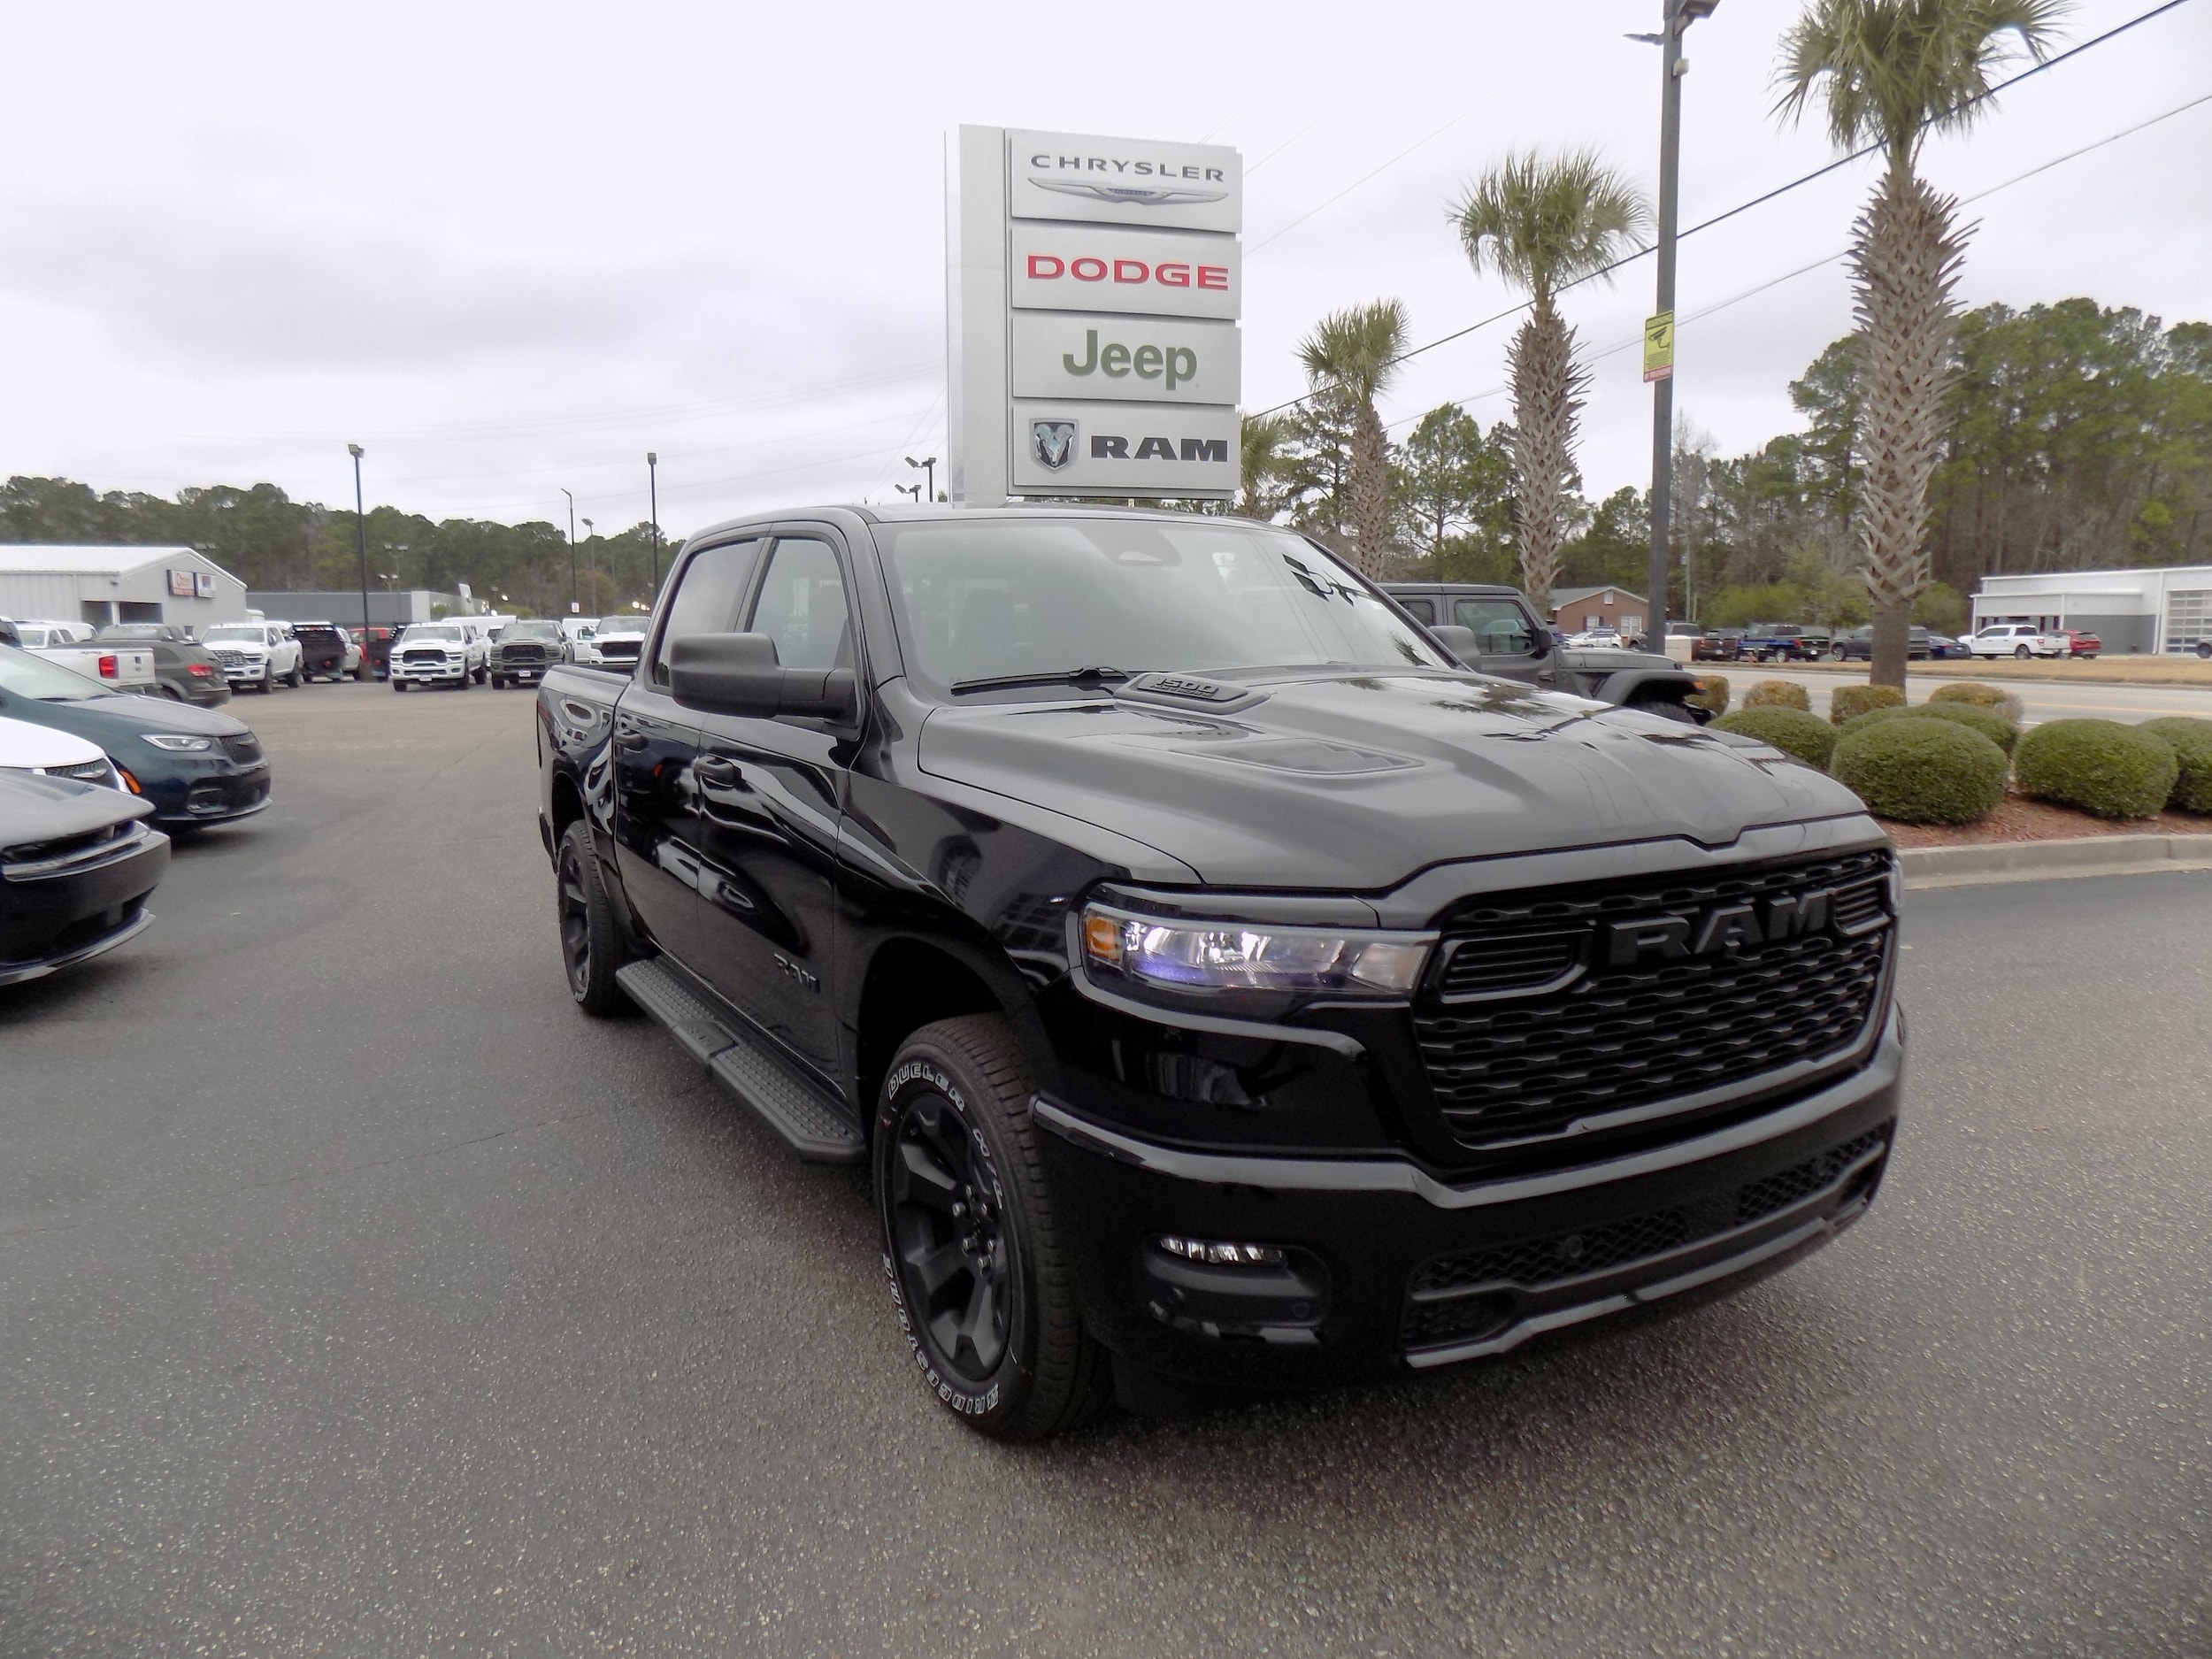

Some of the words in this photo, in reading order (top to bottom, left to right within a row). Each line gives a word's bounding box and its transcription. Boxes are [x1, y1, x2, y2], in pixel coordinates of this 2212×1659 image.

[1031, 154, 1225, 182] CHRYSLER
[1027, 255, 1229, 291] DODGE
[1063, 329, 1197, 390] Jeep
[1090, 435, 1228, 463] RAM
[1156, 678, 1219, 694] 1500
[1609, 890, 1830, 966] RAM
[887, 1063, 965, 1112] DUELER
[882, 1253, 999, 1415] BRIDGESTONE
